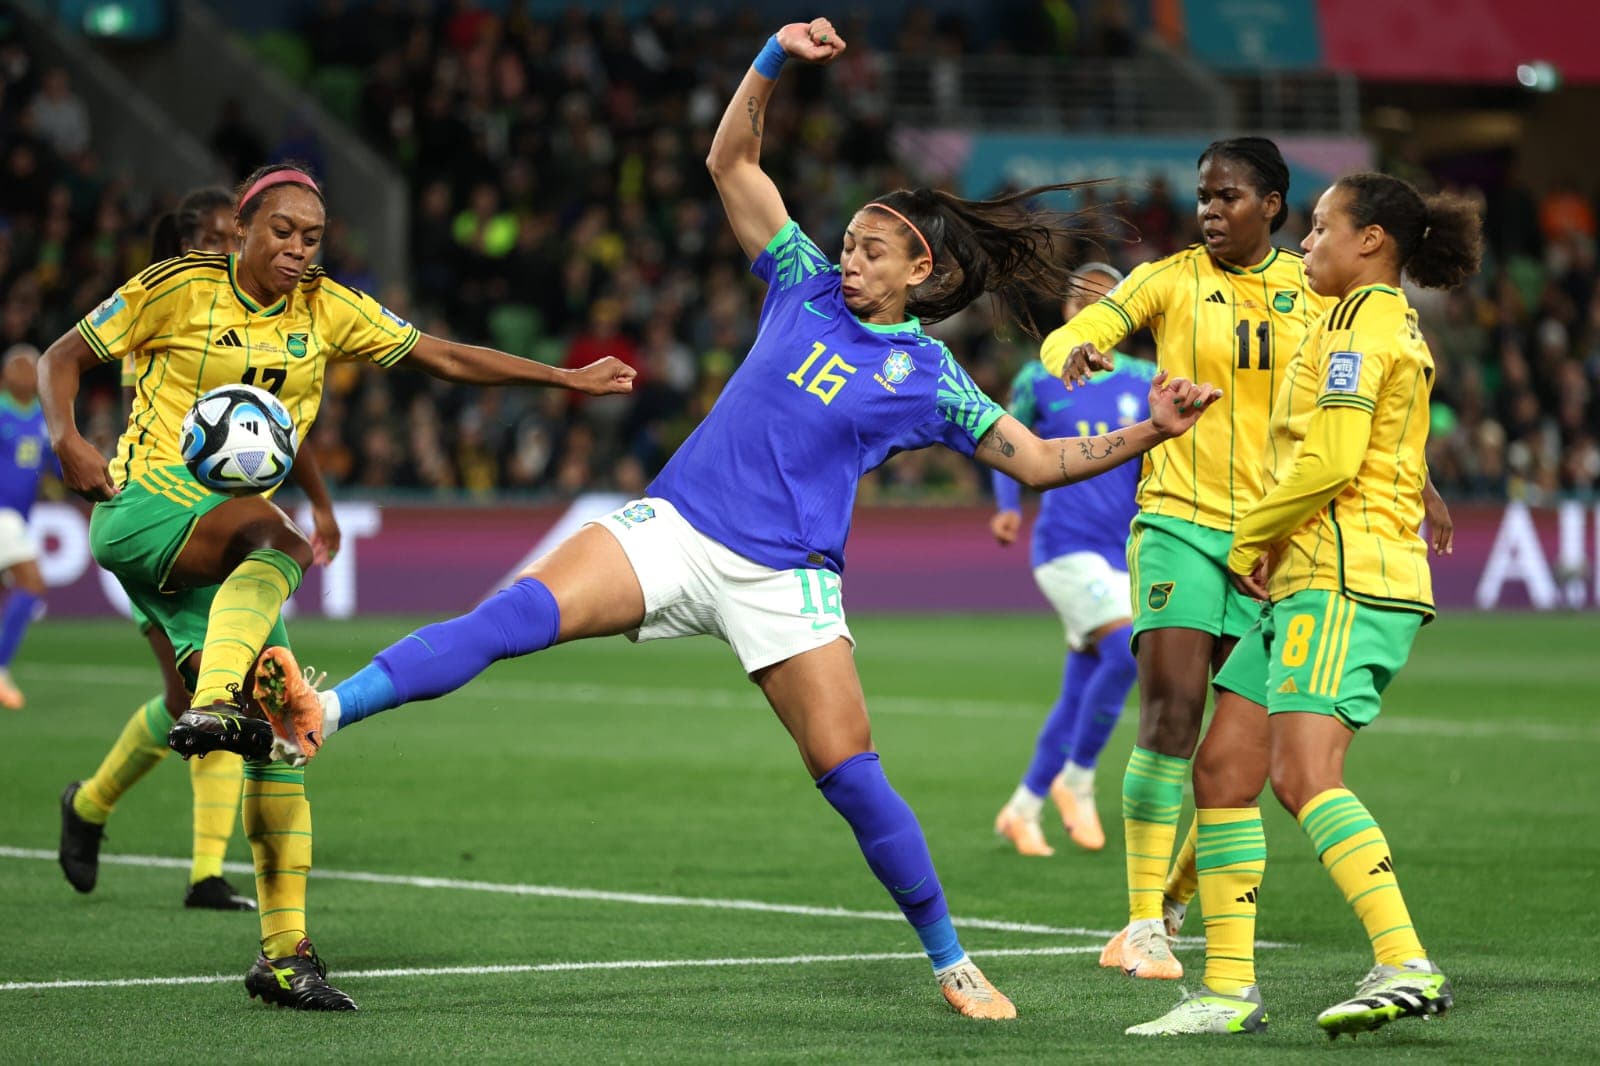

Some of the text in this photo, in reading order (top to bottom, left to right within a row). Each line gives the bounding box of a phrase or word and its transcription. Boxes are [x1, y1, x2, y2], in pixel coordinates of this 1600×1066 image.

[1236, 319, 1270, 370] 11
[786, 340, 858, 406] 16
[872, 372, 897, 394] BRASIL
[794, 568, 842, 619] 16
[1282, 613, 1315, 668] 8
